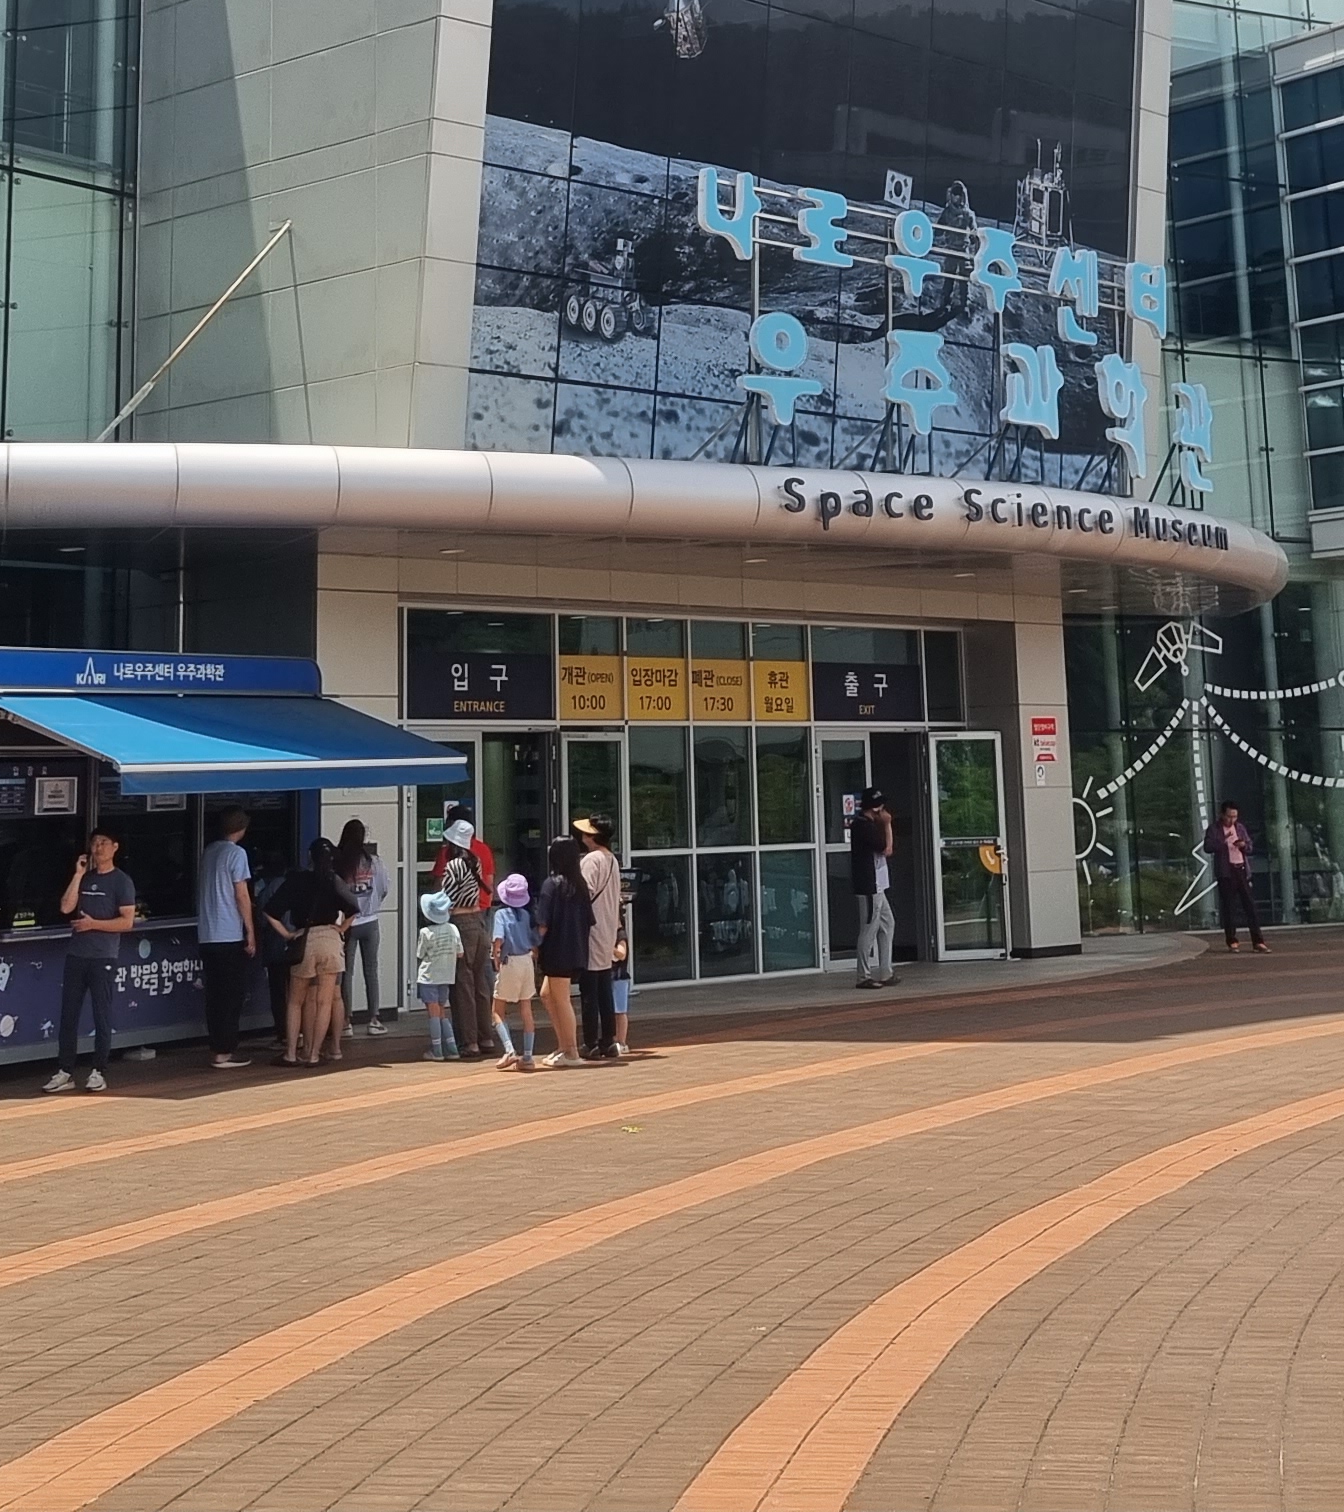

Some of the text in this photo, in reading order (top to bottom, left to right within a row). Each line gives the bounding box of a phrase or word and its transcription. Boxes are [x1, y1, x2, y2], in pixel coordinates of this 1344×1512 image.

[697, 166, 1168, 346] 나로우주센터
[735, 311, 1214, 493] 우주과학관
[782, 477, 1230, 550] Space Science Museum
[113, 662, 174, 681] 나로우주센터
[176, 663, 225, 682] 우주과학관
[630, 667, 679, 687] 입장마감
[767, 670, 790, 689] 휴관
[453, 700, 506, 713] ENTRANCE
[570, 694, 606, 710] 10:00
[639, 695, 672, 711] 17:00
[703, 696, 734, 711] 17:30
[763, 696, 794, 714] 월요일
[858, 704, 875, 715] EXIT
[130, 961, 159, 996] 방문을
[161, 958, 204, 995] 환영합니
